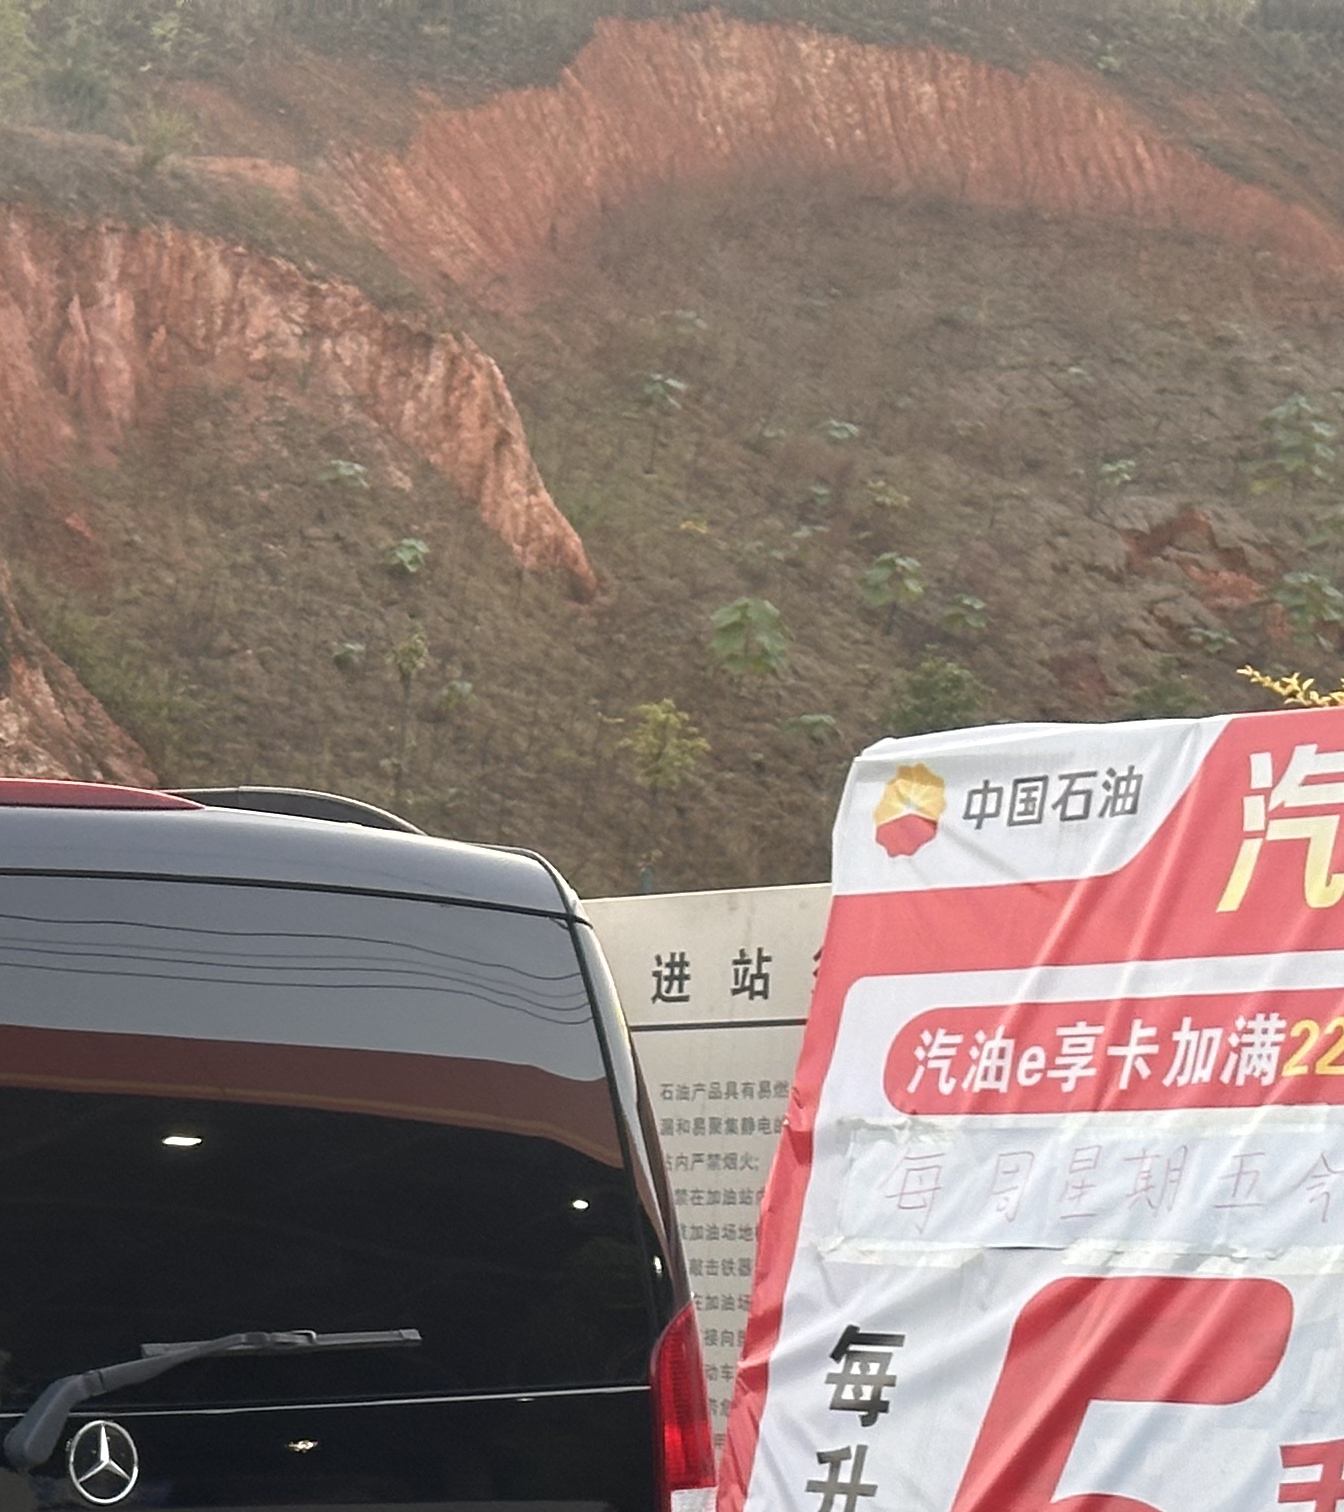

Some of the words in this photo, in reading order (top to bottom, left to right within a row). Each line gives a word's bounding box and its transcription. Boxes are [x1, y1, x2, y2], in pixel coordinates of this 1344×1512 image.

[961, 764, 1144, 831] 中国石油
[1216, 743, 1344, 913] 汽
